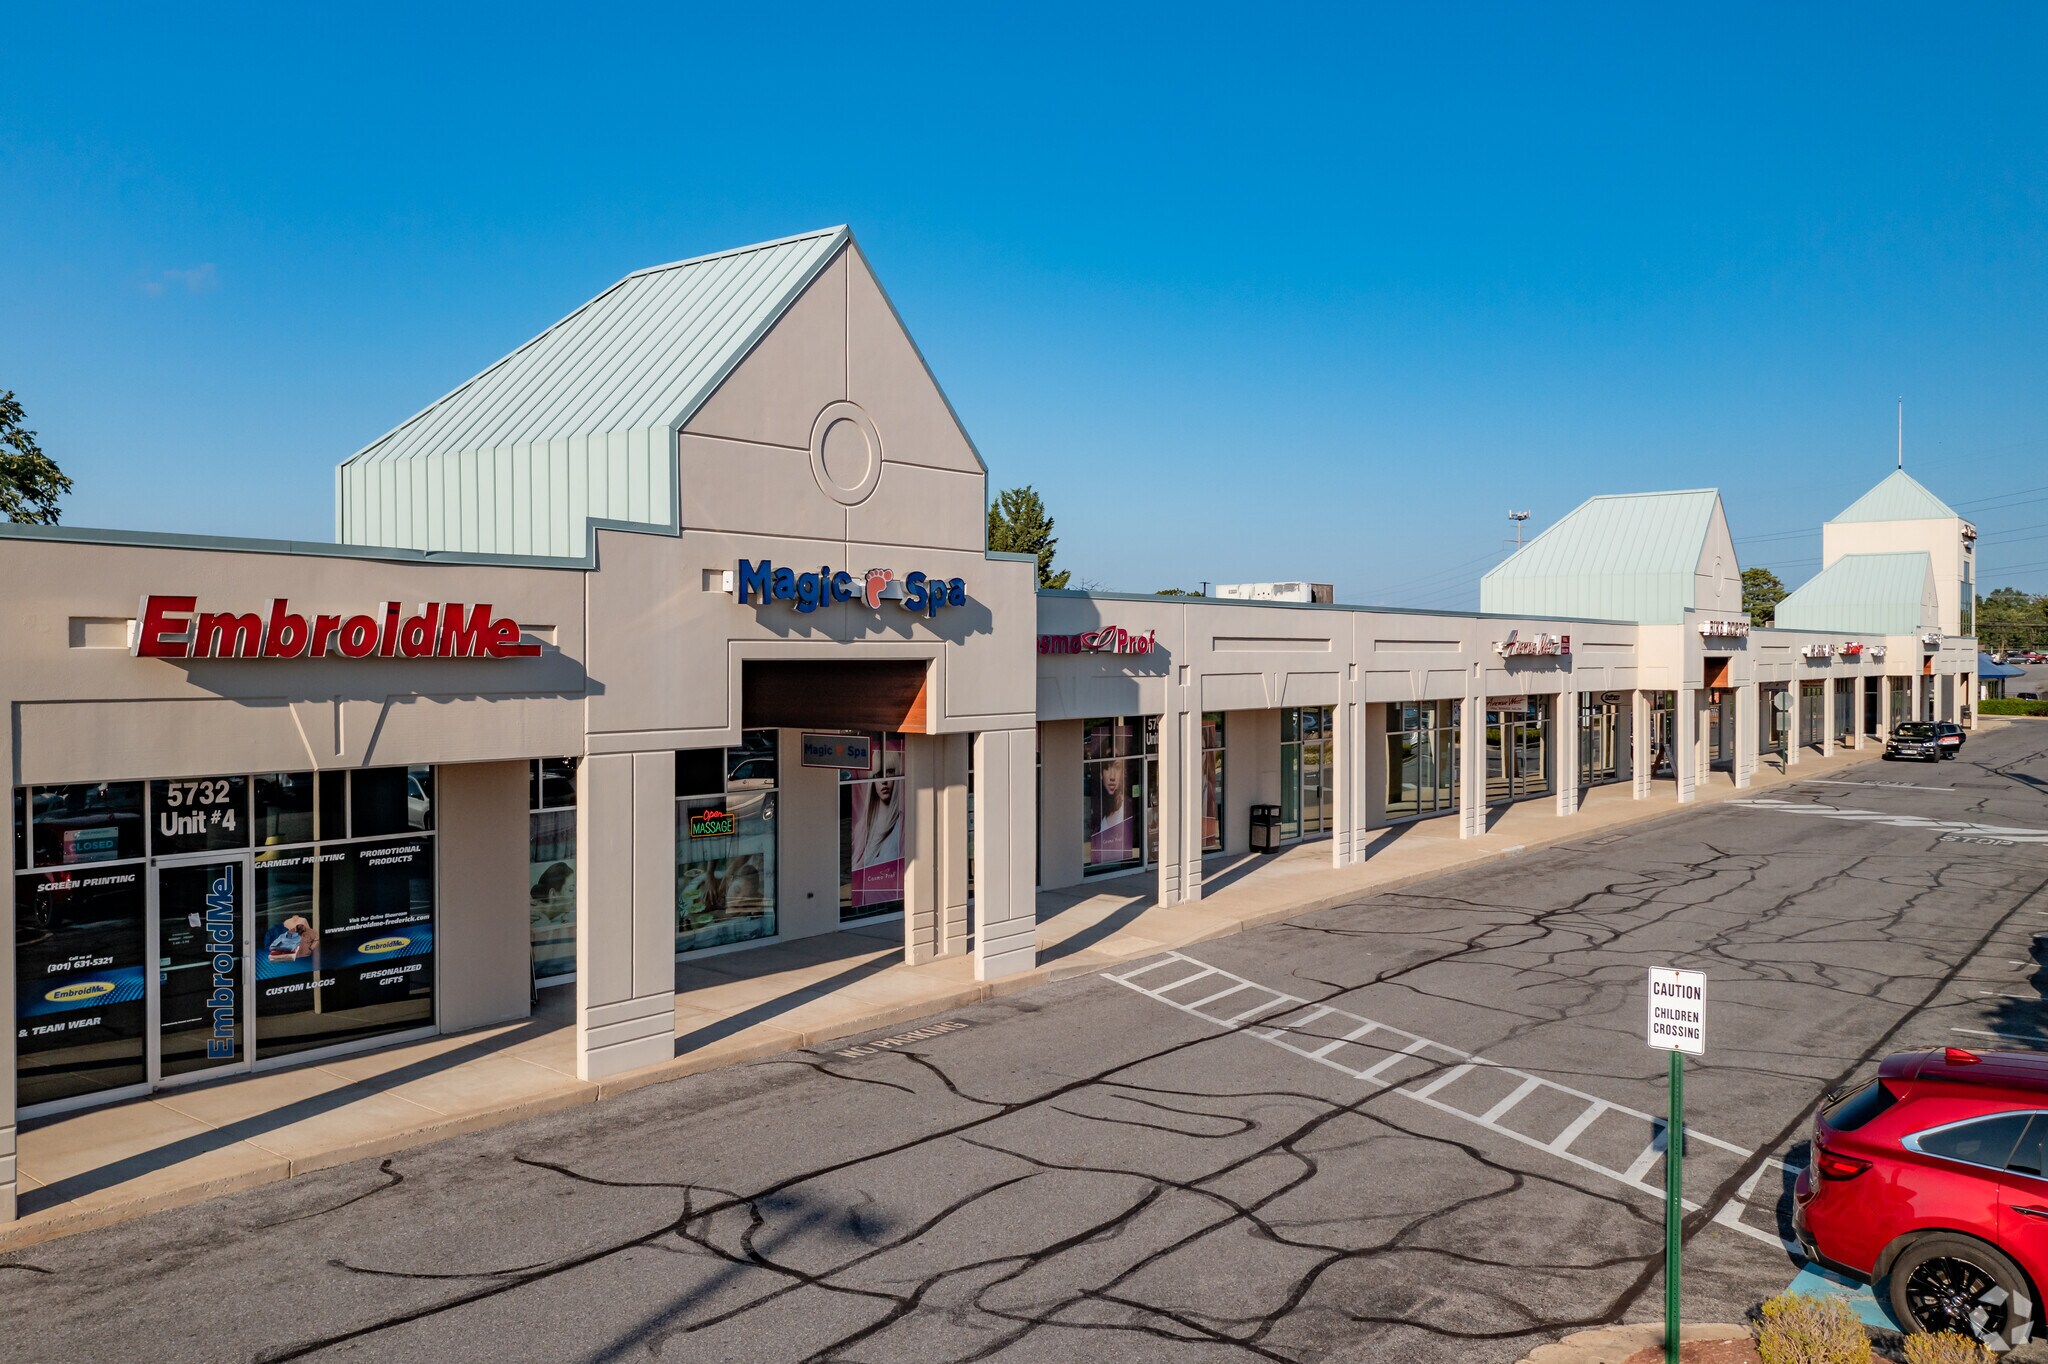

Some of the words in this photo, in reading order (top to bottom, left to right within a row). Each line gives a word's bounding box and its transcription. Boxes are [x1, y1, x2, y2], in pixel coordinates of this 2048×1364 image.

[738, 558, 852, 614] Magic
[904, 570, 967, 618] Spa
[133, 594, 542, 659] EmbroidMe
[1037, 634, 1081, 654] smo
[1115, 628, 1155, 654] Prof
[1486, 697, 1508, 707] Avenue
[1508, 696, 1526, 706] West
[1148, 718, 1159, 731] 57
[804, 744, 832, 757] Magic
[847, 745, 867, 758] Spa
[167, 780, 230, 807] 5732
[161, 810, 207, 837] Unit
[210, 808, 236, 831] #4
[703, 809, 724, 821] Open
[692, 819, 732, 834] MASSAGE
[68, 840, 114, 852] CLOSED
[1940, 834, 2015, 847] STOP
[359, 845, 421, 858] PROMOTIONAL
[255, 857, 300, 869] GARMENT
[302, 853, 345, 864] PRINTING
[368, 855, 413, 866] PRODUCTS
[37, 880, 80, 892] SCREEN
[83, 874, 135, 888] PRINTING
[325, 914, 430, 934] www.embroidme-frederick.com
[364, 940, 405, 951] EmbroidMe
[47, 962, 71, 973] (301)
[73, 956, 114, 969] 631-5321
[206, 865, 234, 1059] EmbroidMe
[360, 963, 422, 980] PERSONALIZED
[266, 983, 304, 996] CUSTOM
[306, 978, 336, 990] LOGOS
[379, 976, 404, 986] GIFTS
[54, 985, 108, 999] EmbroidMe
[1653, 981, 1701, 1000] CAUTION
[1654, 1006, 1699, 1023] CHILDREN
[18, 1029, 28, 1038] &
[32, 1022, 65, 1035] TEAM
[68, 1017, 101, 1030] WEAR
[1653, 1022, 1700, 1039] CROSSING
[835, 1044, 879, 1059] NO
[875, 1021, 969, 1049] PARKING
